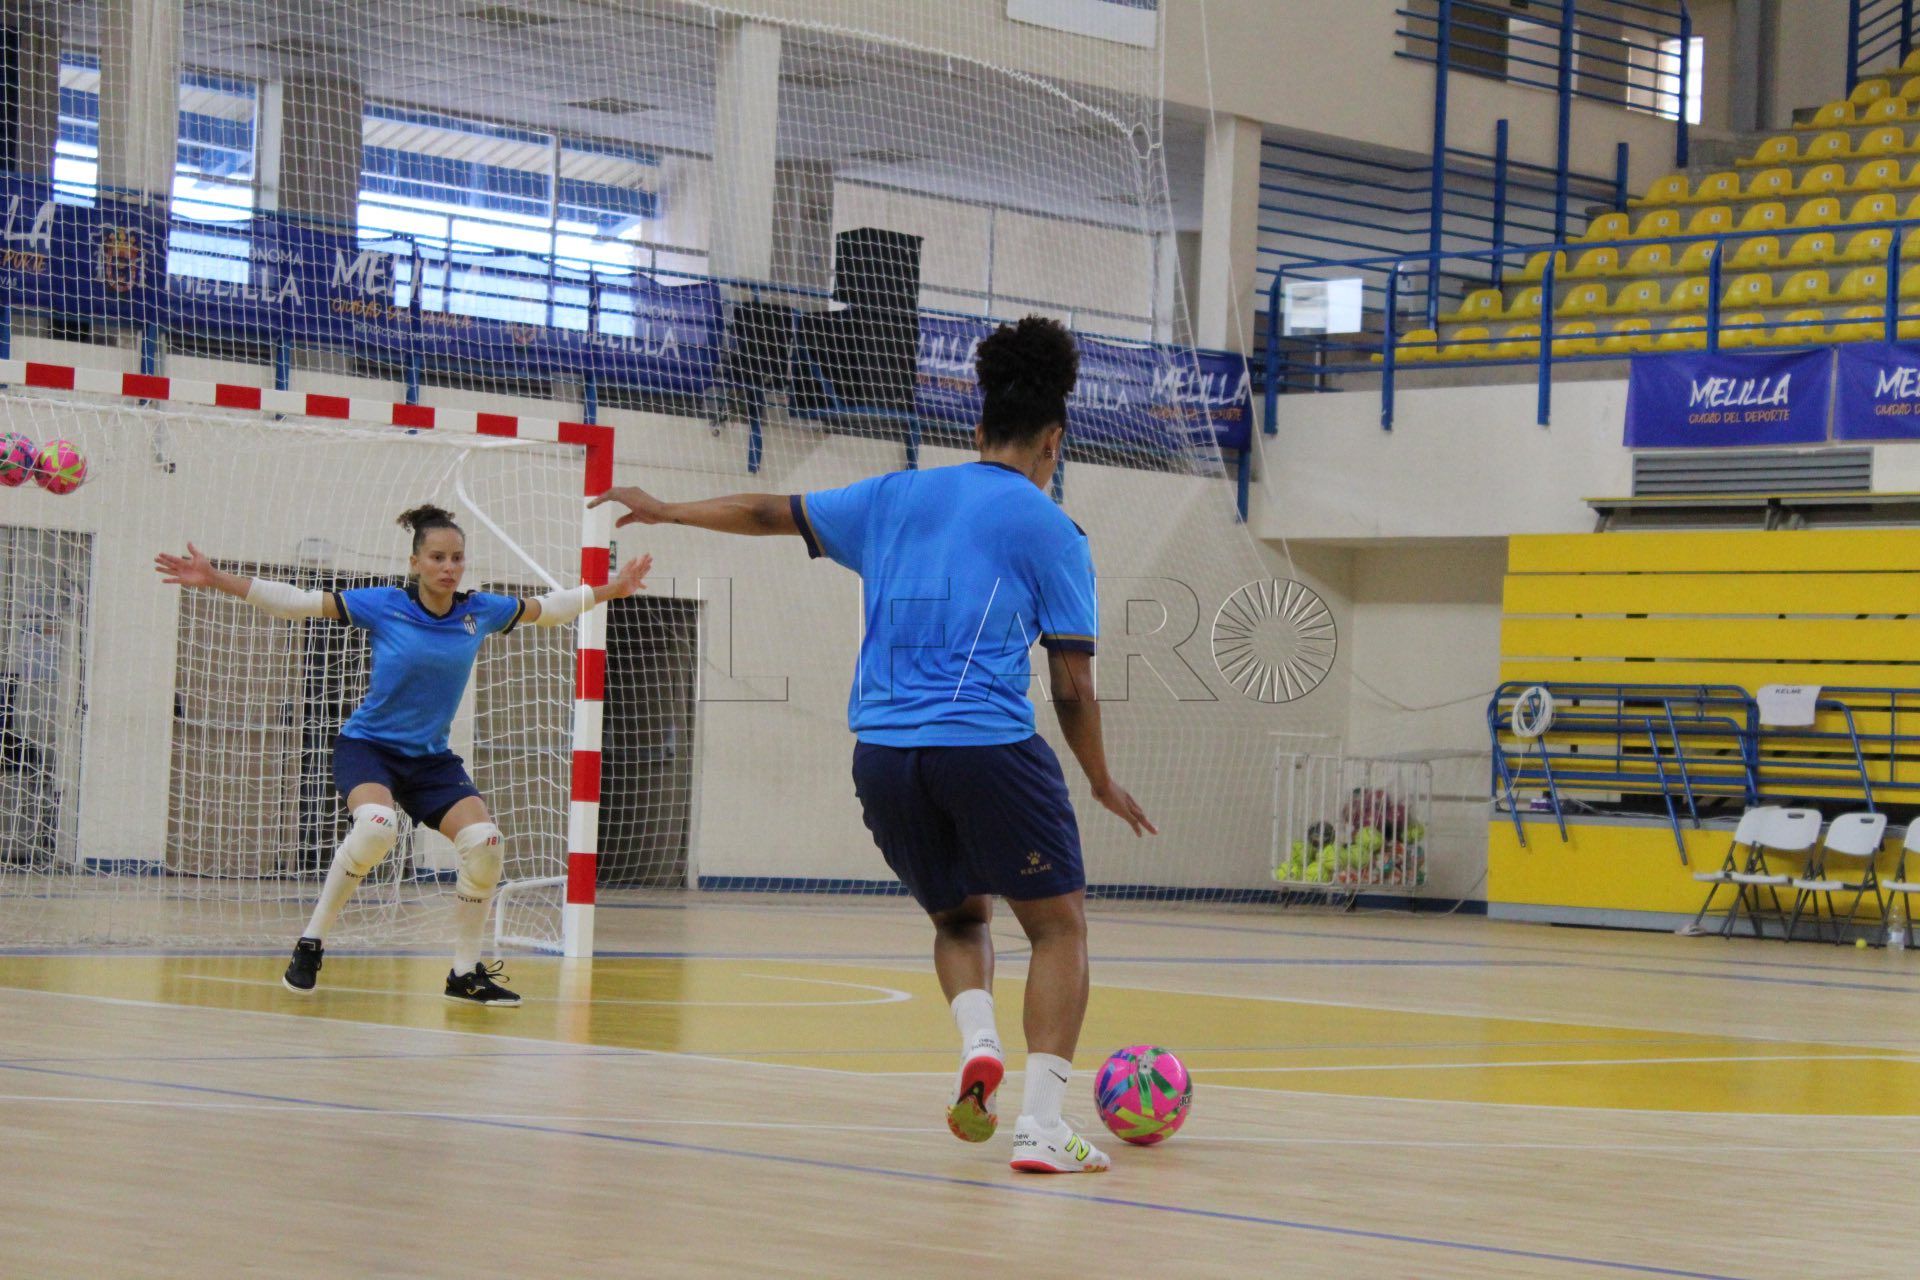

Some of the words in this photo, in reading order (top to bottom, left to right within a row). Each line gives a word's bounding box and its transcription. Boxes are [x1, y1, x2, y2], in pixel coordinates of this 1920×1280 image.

[1150, 366, 1249, 406] MELILLA
[1689, 373, 1791, 409] MELILLA
[1689, 413, 1721, 424] CIUDAD
[1724, 412, 1740, 423] DEL
[1744, 409, 1790, 423] DEPORTE
[1020, 863, 1053, 876] KELME
